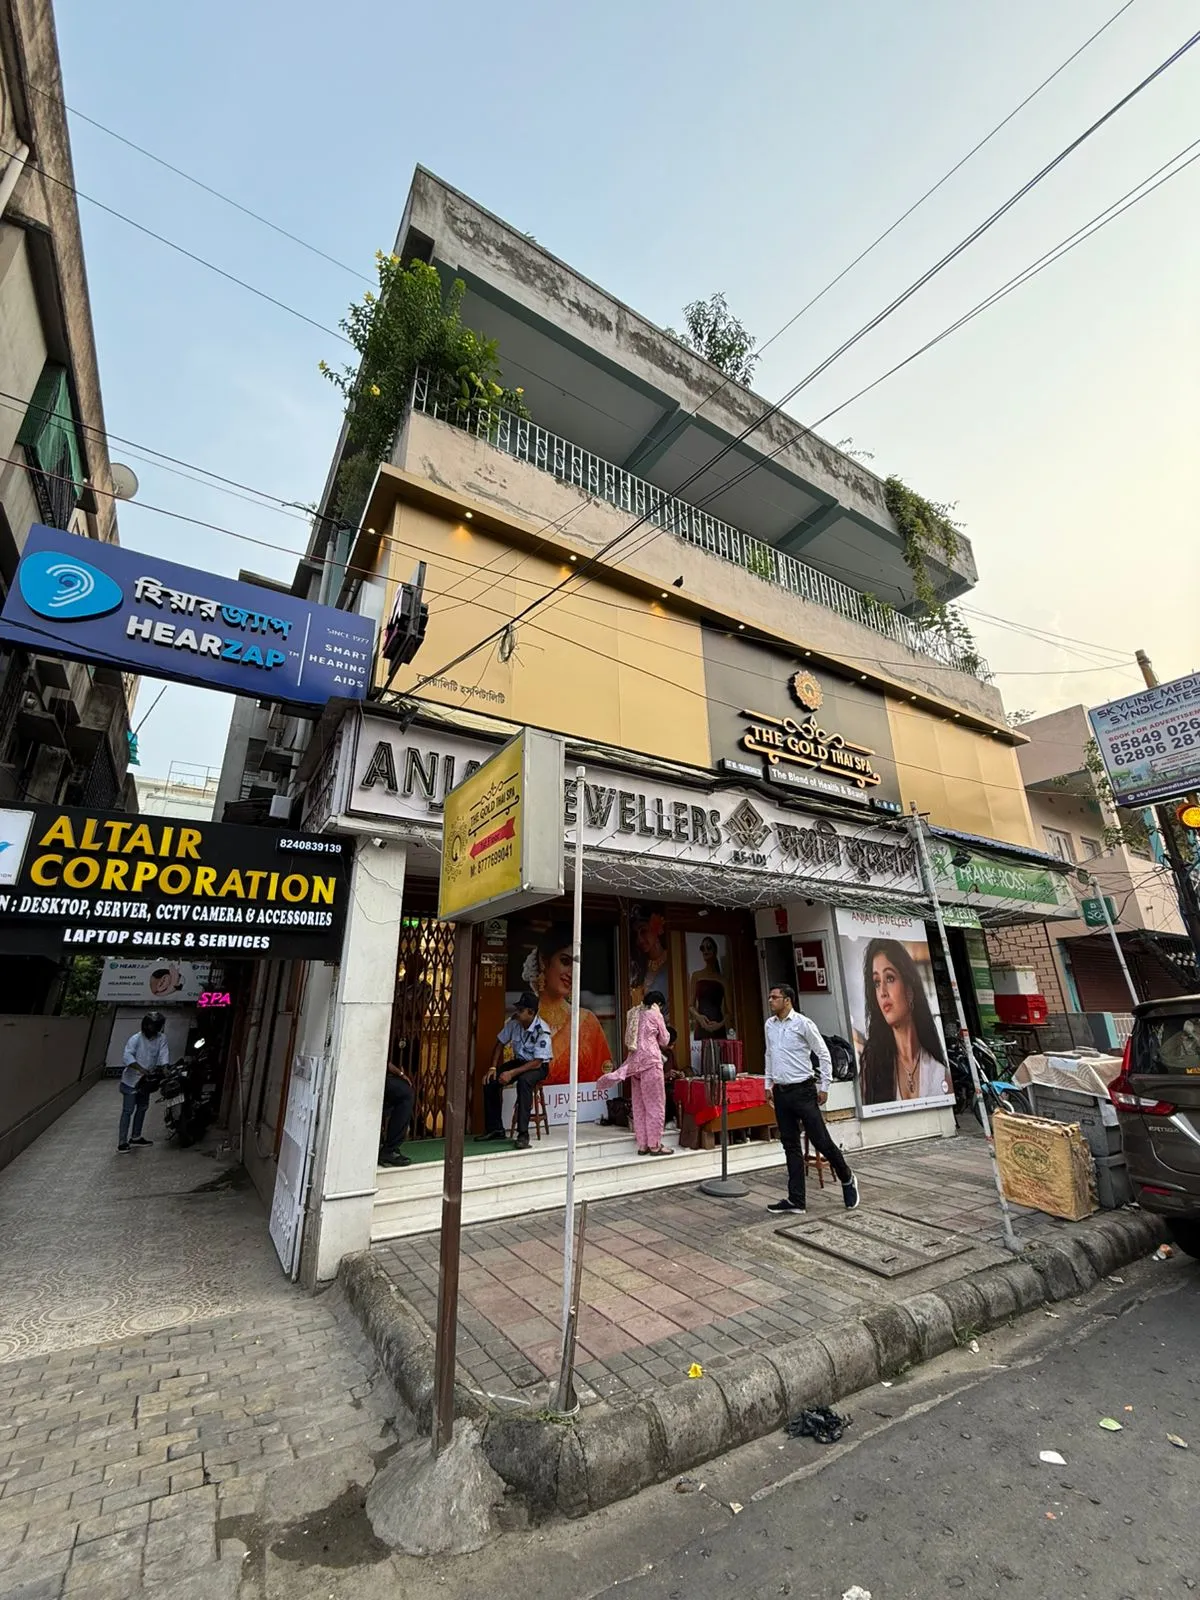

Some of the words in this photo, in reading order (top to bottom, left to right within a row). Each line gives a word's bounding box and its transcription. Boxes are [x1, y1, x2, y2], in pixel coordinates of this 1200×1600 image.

[126, 615, 286, 668] HEARZAP
[325, 644, 367, 661] SMART
[309, 654, 366, 674] HEARING
[334, 675, 364, 688] AIDS
[1097, 693, 1155, 719] SKYLINE
[1160, 678, 1200, 697] MEDI
[1109, 731, 1130, 742] BOOK
[1132, 725, 1148, 736] FOR
[1110, 730, 1162, 754] 85849
[751, 725, 784, 747] THE
[787, 737, 828, 760] GOLD
[831, 749, 854, 767] THAI
[855, 756, 873, 774] SPA
[1115, 742, 1167, 766] 62896
[772, 768, 787, 780] The
[788, 772, 809, 785] Blend
[810, 778, 818, 787] of
[818, 779, 839, 792] Health
[564, 778, 722, 848] EWELLERS
[38, 815, 203, 859] ALTAIR
[279, 838, 342, 853] 8240839139
[30, 854, 337, 905] CORPORATION
[19, 896, 91, 919] DESKTOP,
[94, 900, 151, 921] SERVER,
[156, 904, 191, 921] CCTV
[192, 906, 243, 923] CAMERA
[245, 909, 256, 923] &
[256, 908, 333, 926] ACCESSORIES
[63, 928, 130, 944] LAPTOP
[132, 931, 181, 946] SALES
[184, 933, 195, 947] &
[199, 933, 271, 949] SERVICES
[198, 992, 231, 1005] SPA
